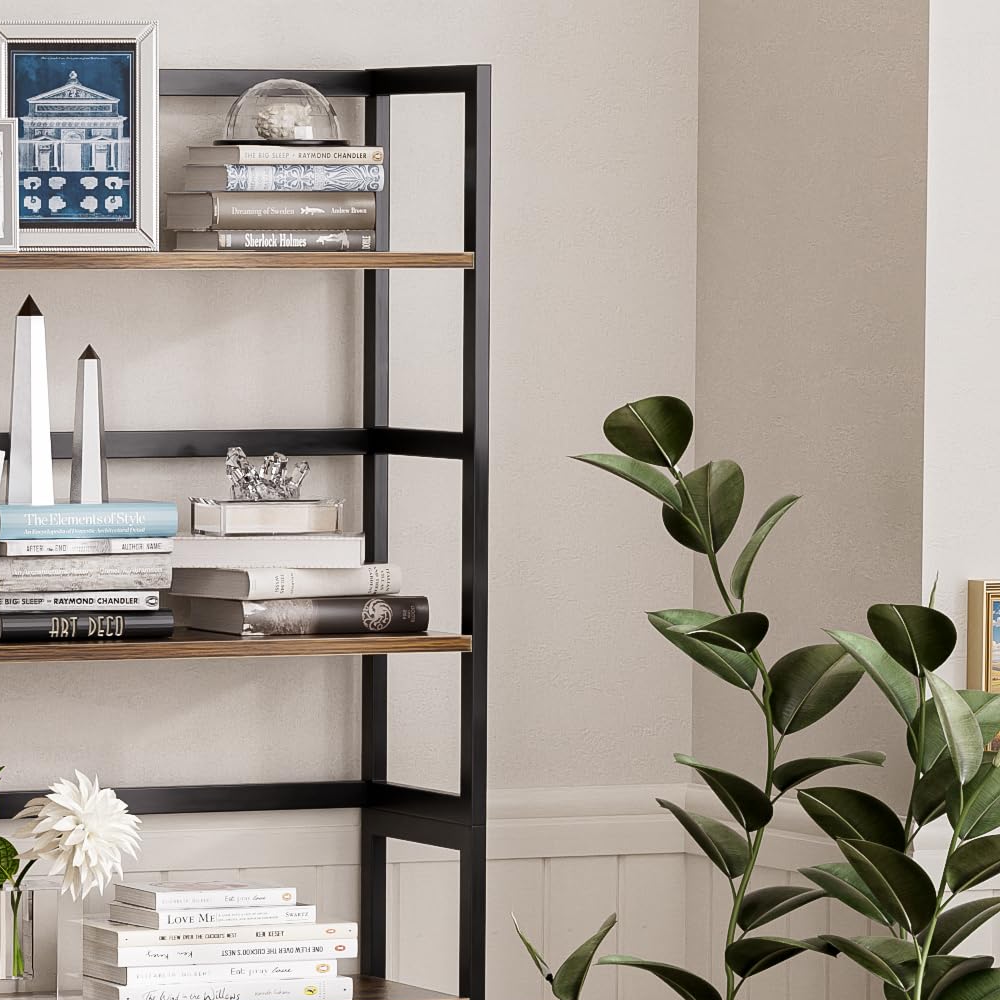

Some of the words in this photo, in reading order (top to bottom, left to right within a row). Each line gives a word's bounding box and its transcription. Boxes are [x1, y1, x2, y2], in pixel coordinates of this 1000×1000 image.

[263, 206, 271, 215] of
[245, 233, 277, 247] Sherlock
[279, 233, 307, 247] Holmes
[24, 513, 48, 526] The
[49, 512, 103, 526] Elements
[104, 512, 117, 525] of
[117, 511, 145, 526] Style
[55, 544, 67, 552] END
[147, 542, 162, 550] NAME
[97, 597, 138, 605] CHANDLER
[49, 616, 79, 638] ART
[88, 615, 124, 637] DECO
[221, 949, 236, 957] NEST
[266, 947, 277, 955] THE
[160, 991, 181, 1000] Wind
[203, 987, 241, 1000] Willows
